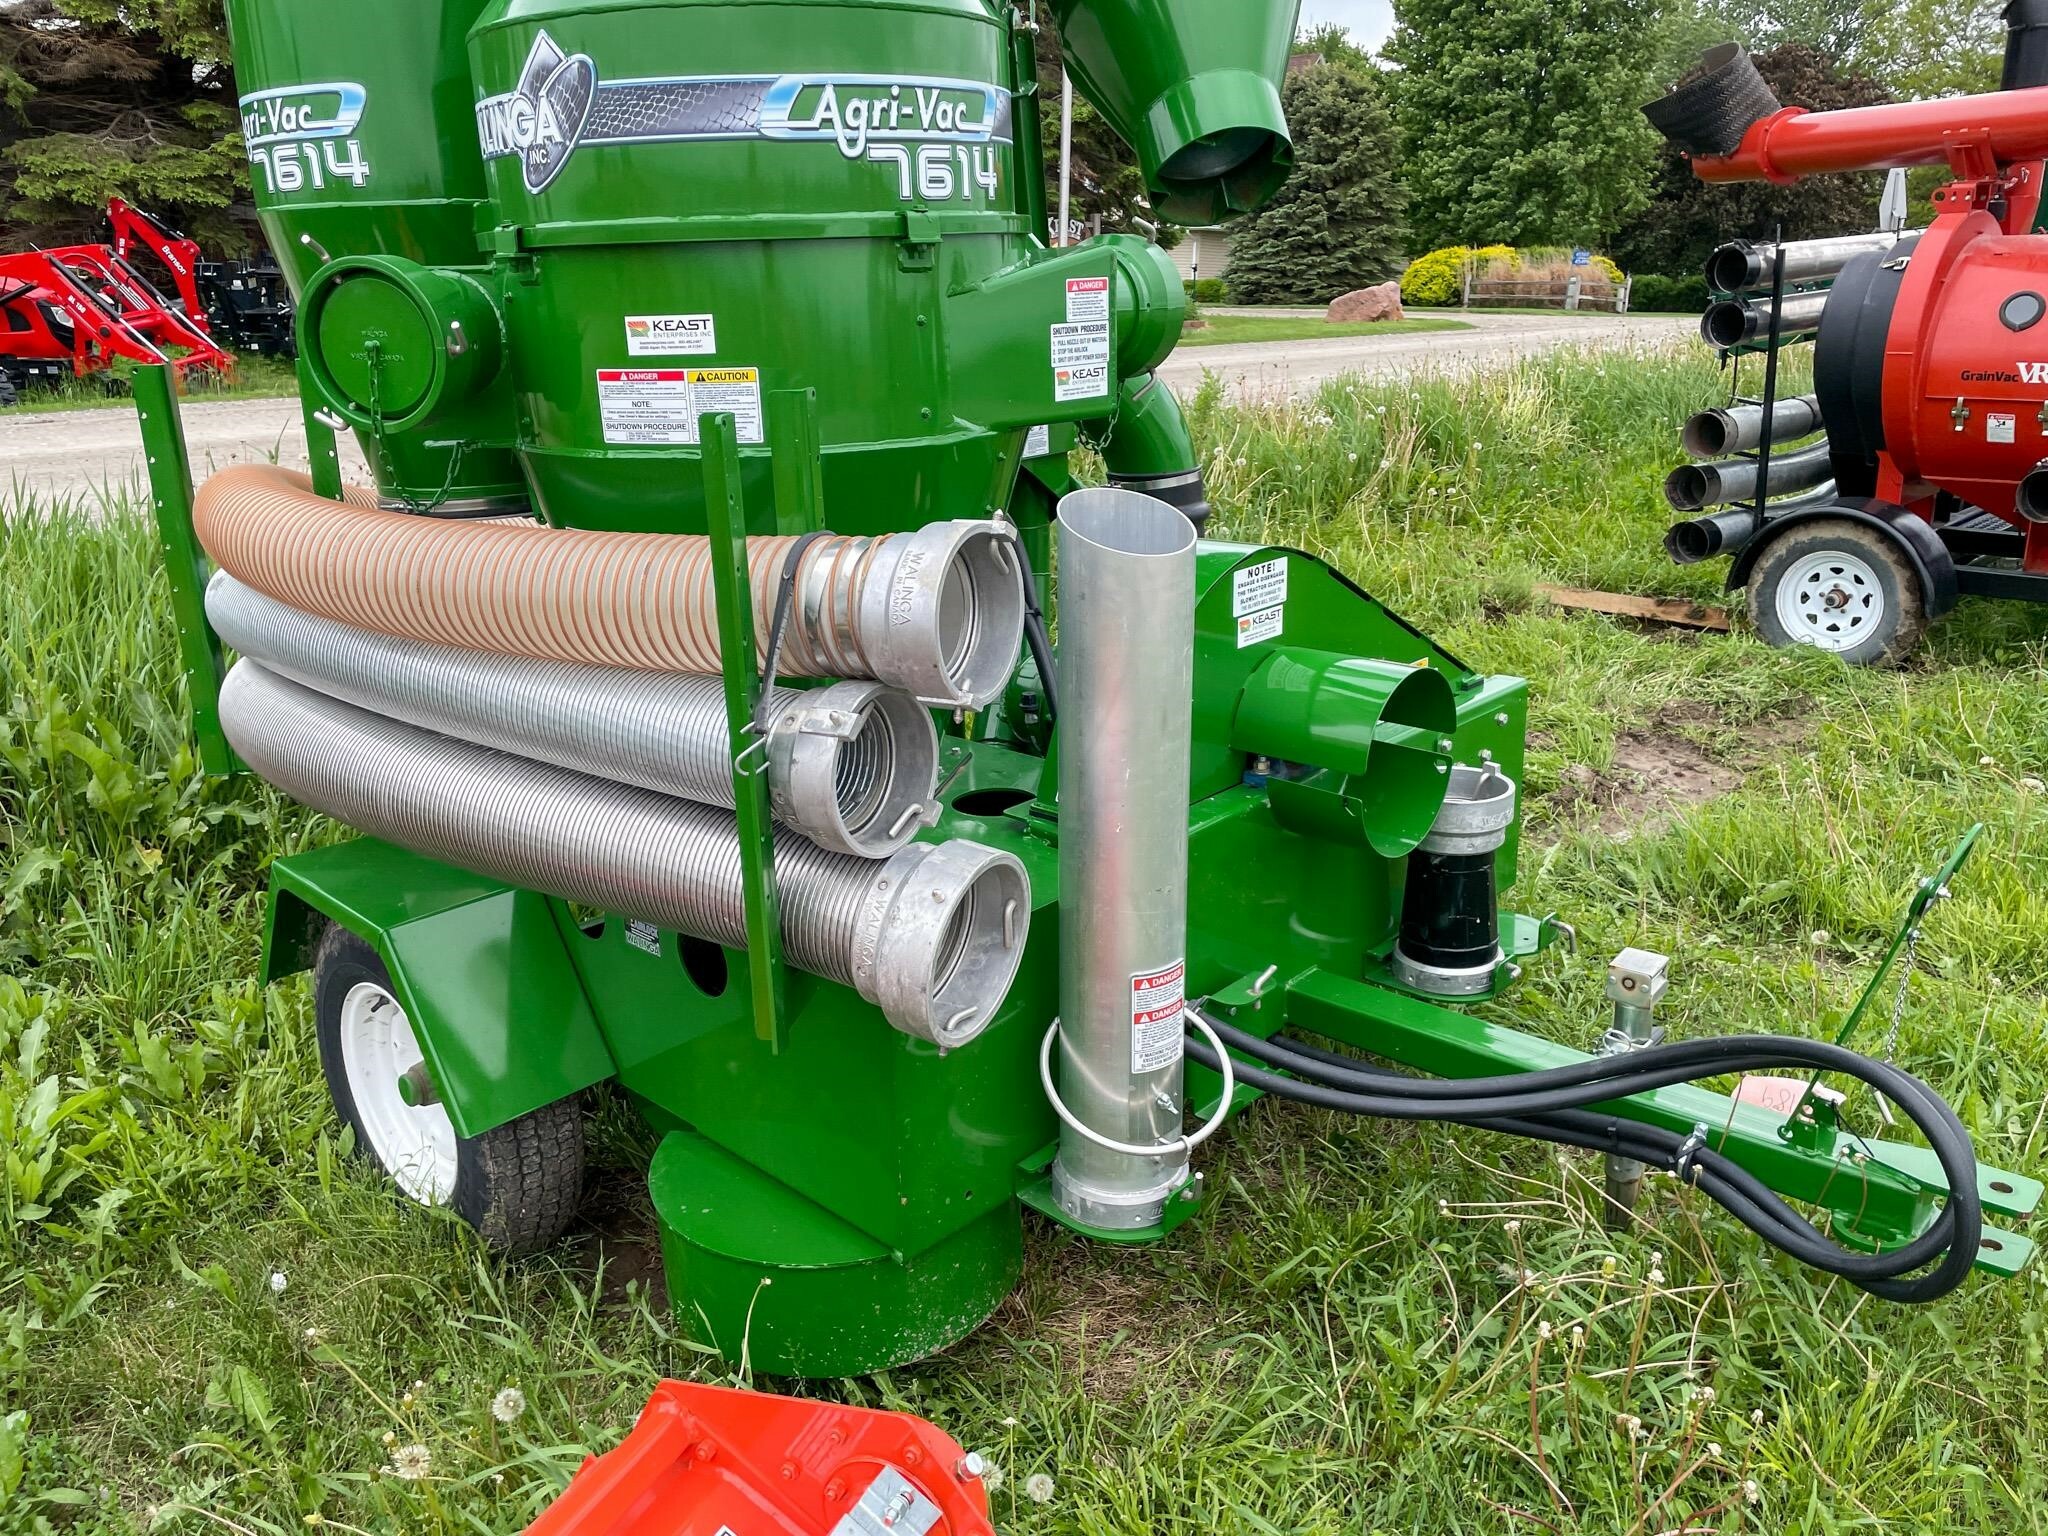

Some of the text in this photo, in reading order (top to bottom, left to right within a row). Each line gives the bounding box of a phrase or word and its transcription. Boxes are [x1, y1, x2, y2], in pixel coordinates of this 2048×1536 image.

[475, 95, 565, 158] ALINGA
[805, 84, 970, 158] Agri-Vac
[241, 97, 312, 162] gri-Vac
[529, 149, 551, 165] INC.
[252, 140, 370, 193] 7614
[866, 144, 998, 201] 7614
[1047, 216, 1085, 236] KST
[162, 245, 187, 275] Branson
[1079, 281, 1103, 289] DANGER
[653, 319, 710, 331] KEAST
[1053, 323, 1107, 335] SHUTDOWN PROCEDURE
[653, 331, 698, 339] ENTERPRISES
[629, 372, 658, 380] DANGER
[706, 372, 749, 381] CAUTION
[1072, 367, 1106, 378] KEAST
[1960, 370, 2019, 382] GrainVac
[1247, 562, 1276, 578] NOTE!
[899, 552, 925, 625] WALINGA
[1247, 583, 1267, 595] TRACTOR
[1252, 609, 1281, 625] KEAST
[1152, 968, 1182, 986] DANGER
[1151, 1000, 1182, 1020] DANGER
